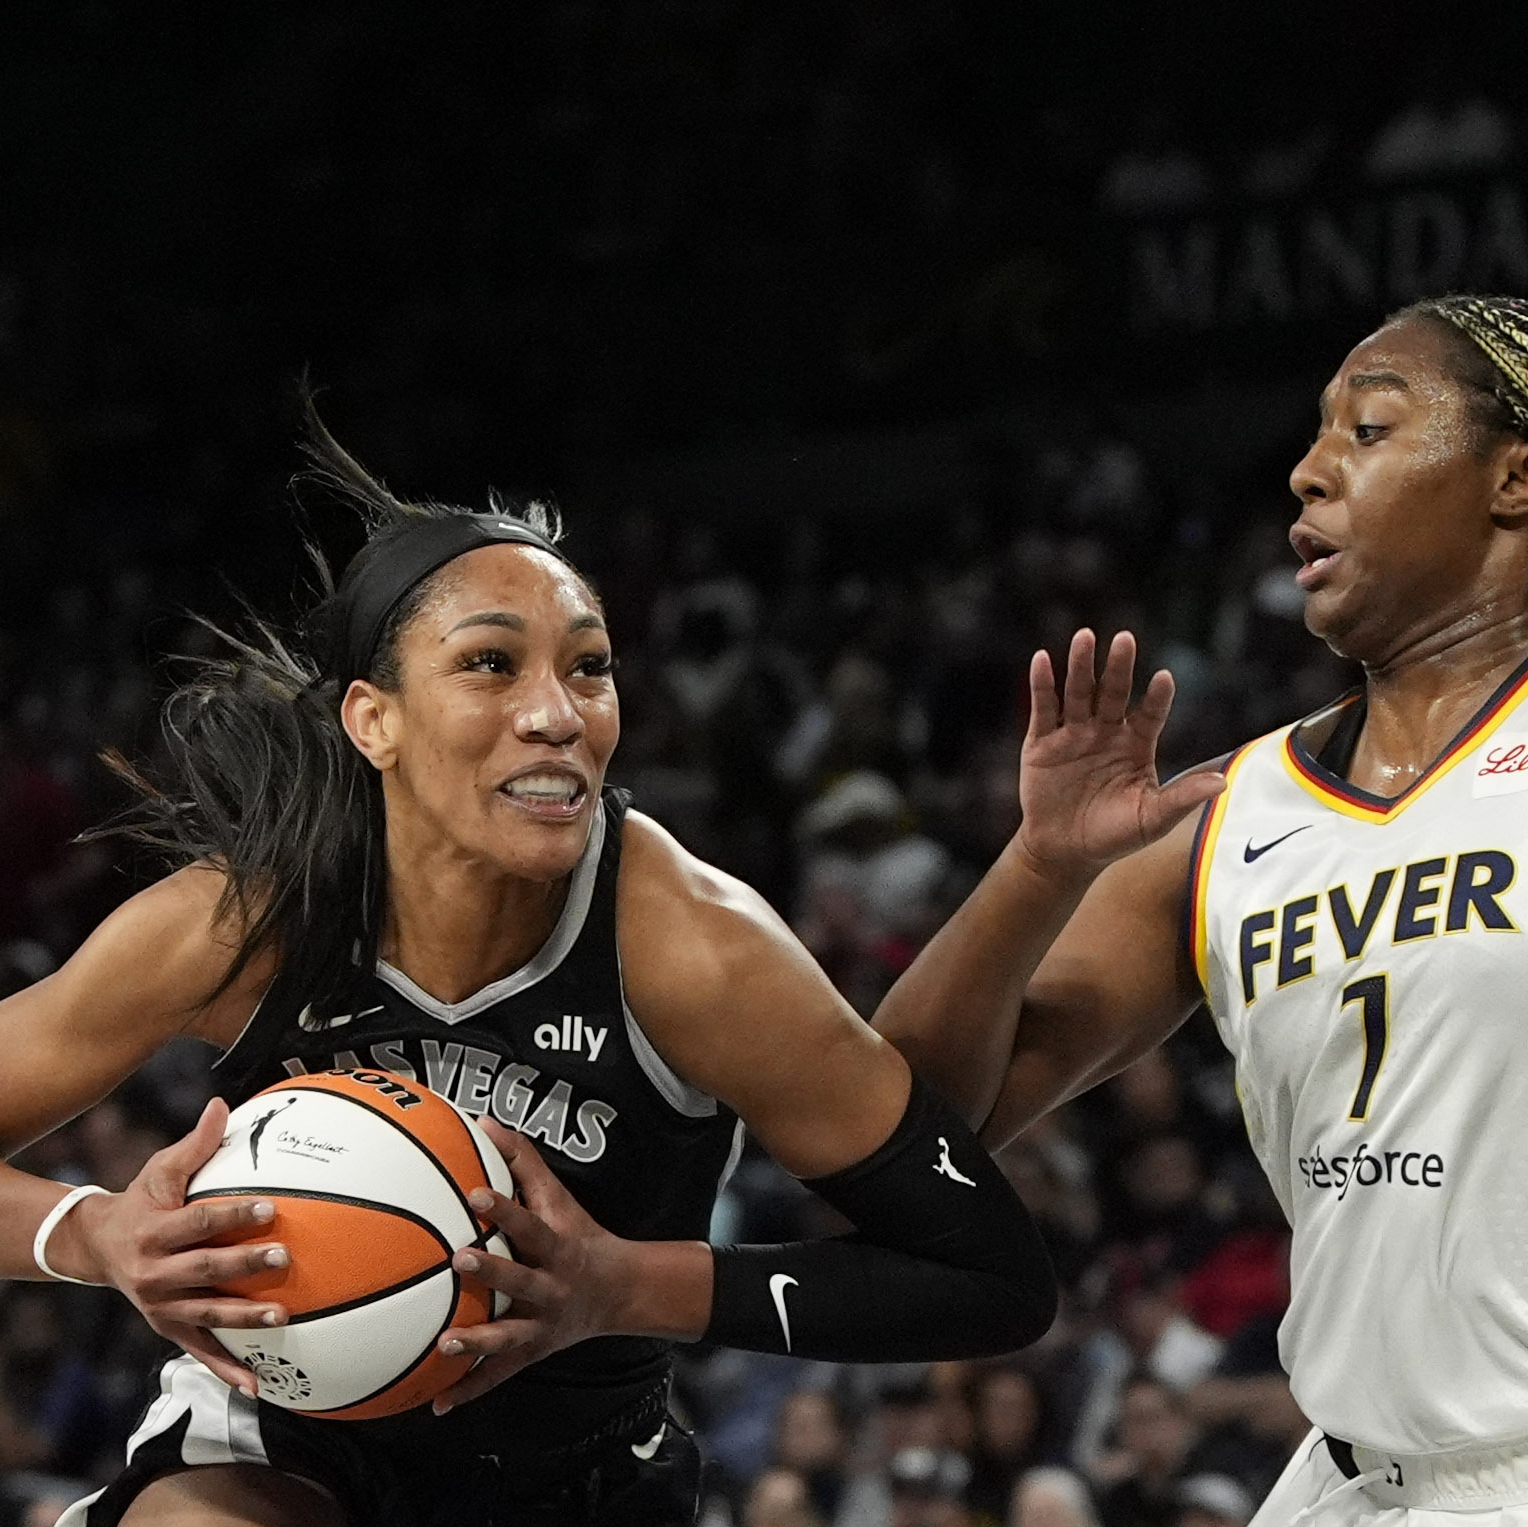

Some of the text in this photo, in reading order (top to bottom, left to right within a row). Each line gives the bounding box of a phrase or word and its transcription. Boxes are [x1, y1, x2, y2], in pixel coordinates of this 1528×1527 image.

[1238, 848, 1521, 1008] FEVER
[420, 1039, 618, 1163] VEGAS
[533, 1014, 609, 1062] ally
[1339, 970, 1392, 1125] 1
